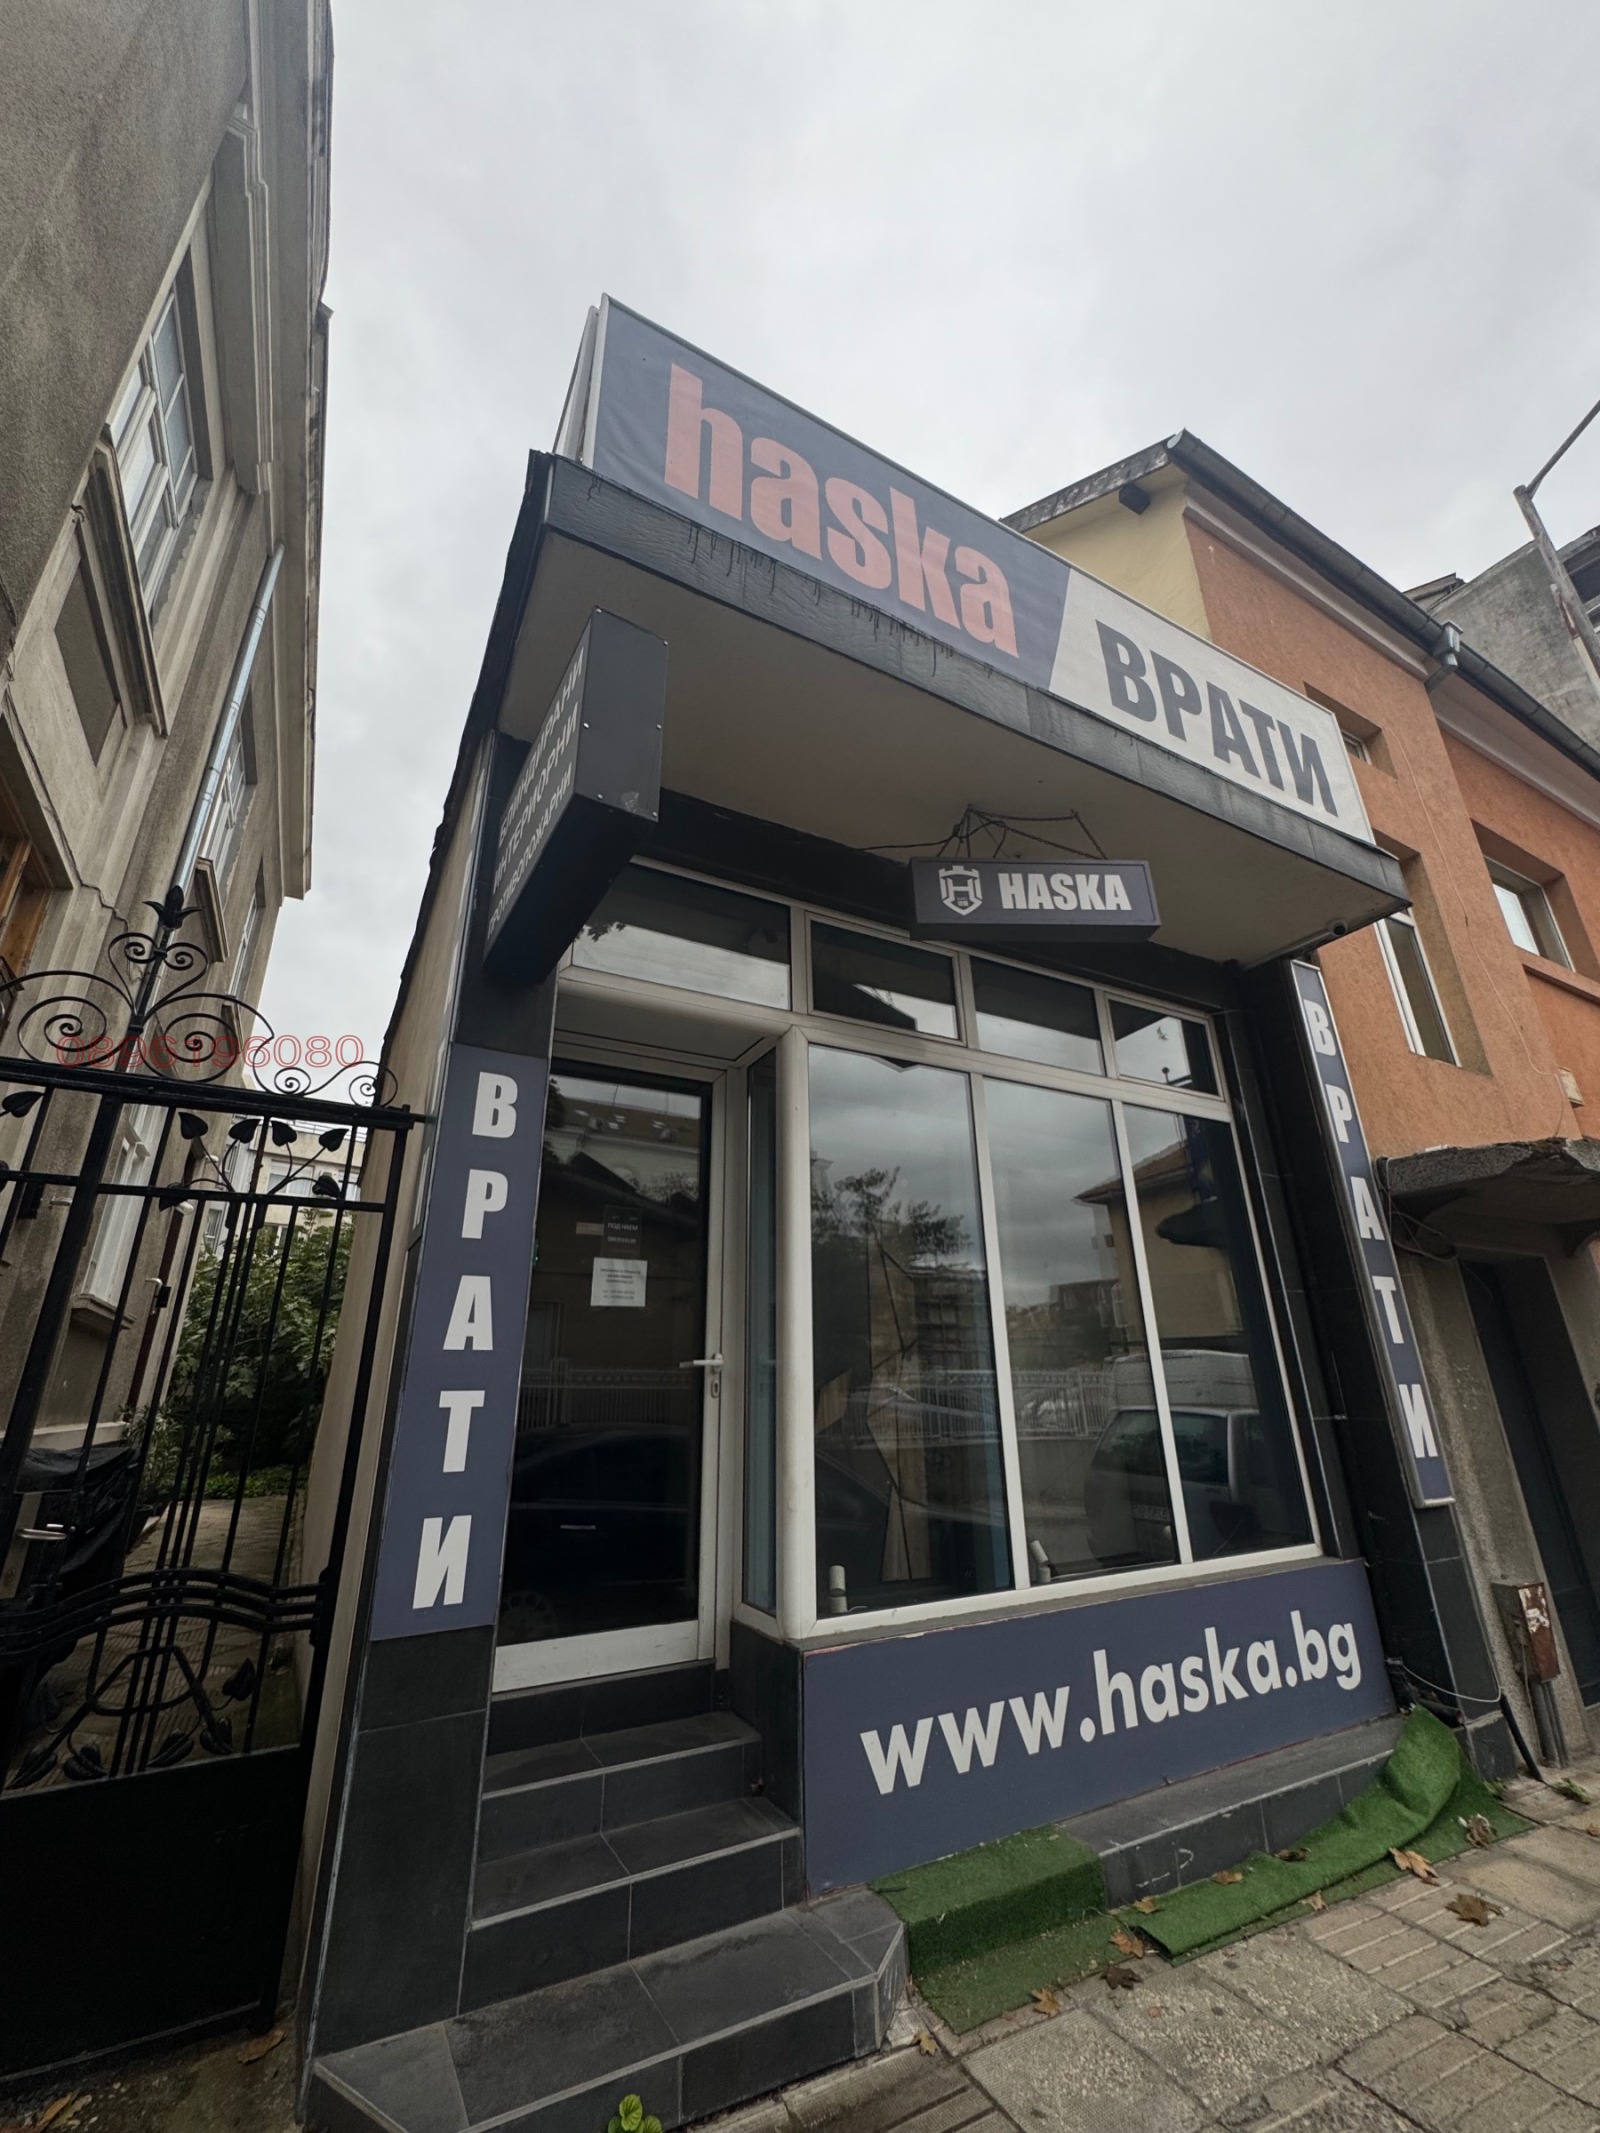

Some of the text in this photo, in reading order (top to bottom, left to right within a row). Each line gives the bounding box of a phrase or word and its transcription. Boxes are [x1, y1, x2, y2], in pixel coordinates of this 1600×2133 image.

[664, 362, 1019, 659] haska
[492, 702, 579, 896] ИНТЕРИОРНИ
[498, 646, 584, 849] БЛИНДИРАНИ
[1094, 618, 1339, 818] ВРАТИ
[998, 872, 1133, 912] HASKA
[1302, 999, 1438, 1460] ВРАТИ
[411, 1070, 519, 1611] ВРАТИ
[859, 1609, 1363, 1796] www.haska.bg
